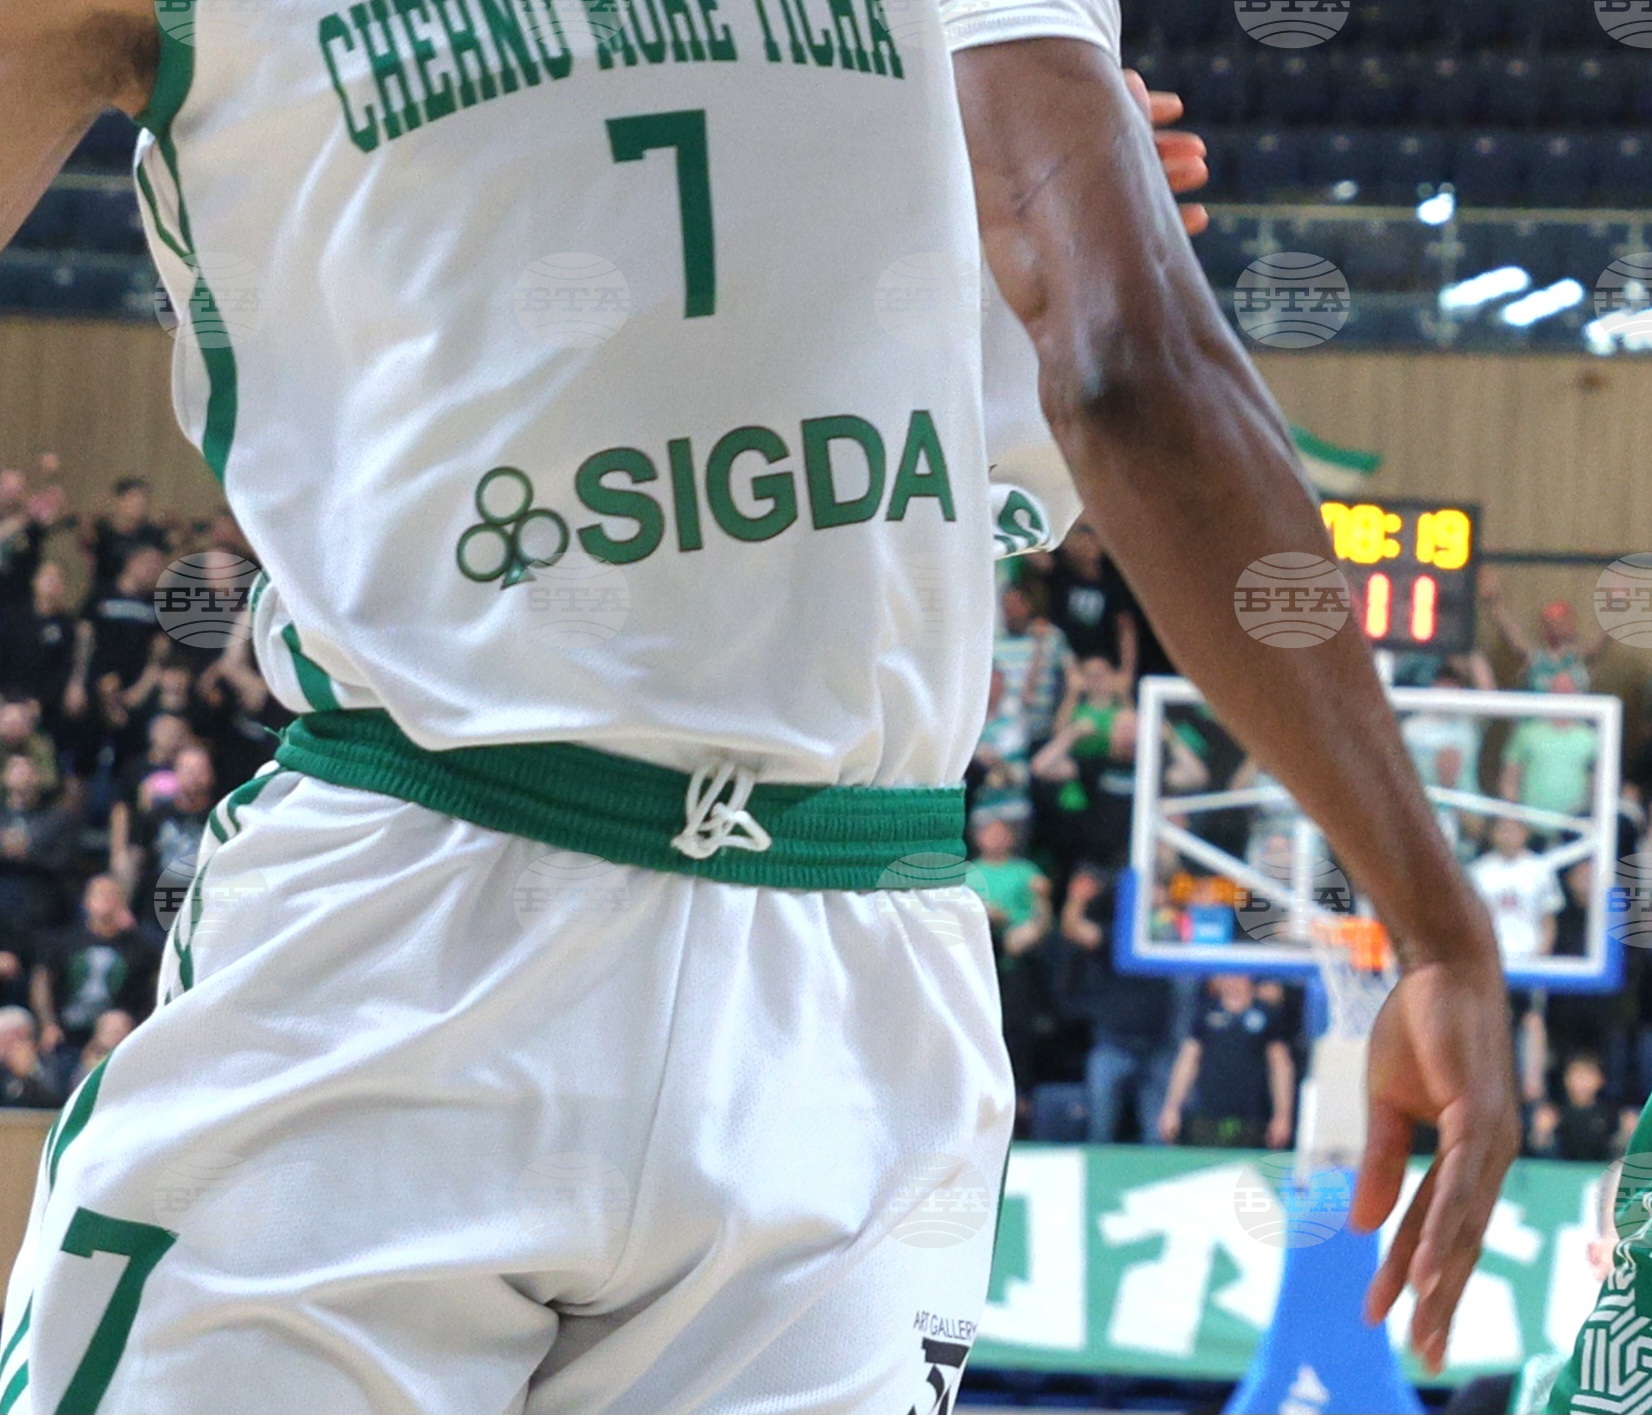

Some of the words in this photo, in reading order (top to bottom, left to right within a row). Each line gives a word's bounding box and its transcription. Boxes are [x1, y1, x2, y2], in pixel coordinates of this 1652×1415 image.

[605, 109, 716, 319] 7
[575, 409, 956, 565] SIGDA
[1365, 571, 1437, 644] 11
[60, 1206, 180, 1415] 7
